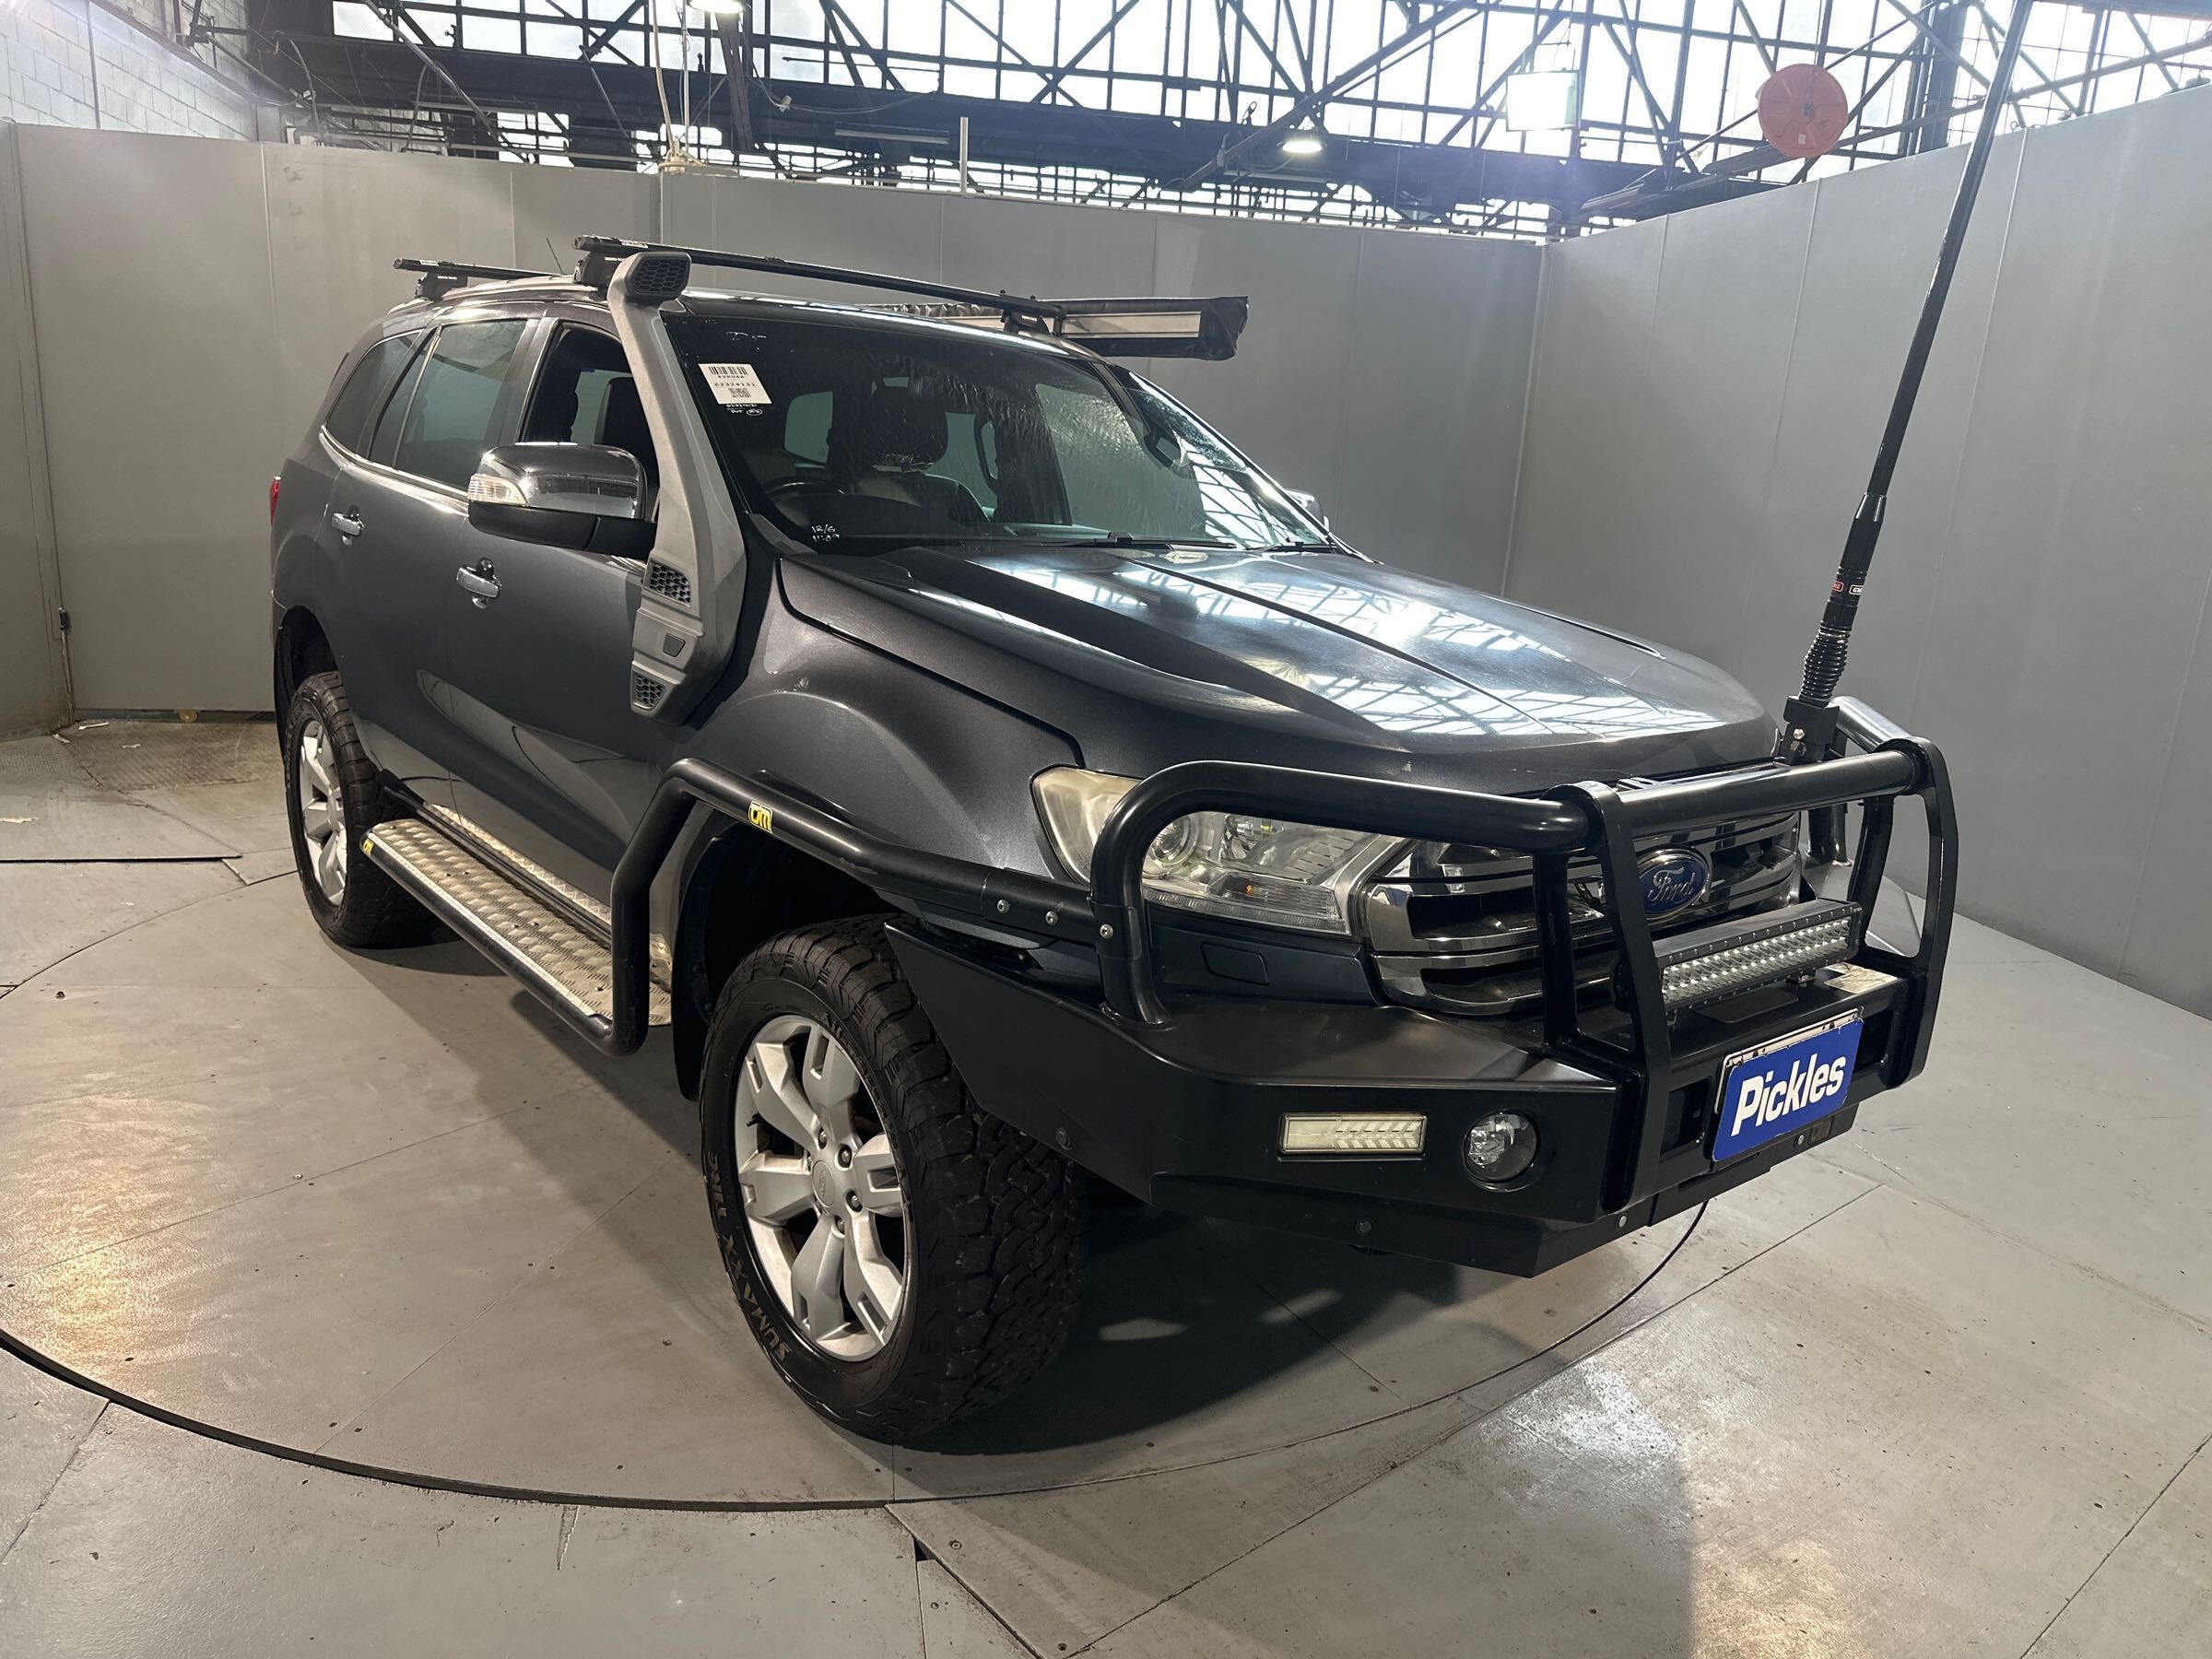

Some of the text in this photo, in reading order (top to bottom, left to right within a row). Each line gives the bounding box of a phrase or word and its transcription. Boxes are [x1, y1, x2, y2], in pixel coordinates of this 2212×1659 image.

[1647, 866, 1696, 902] Ford
[1731, 1053, 1846, 1136] Pickles
[723, 1233, 792, 1361] SUMAXX
